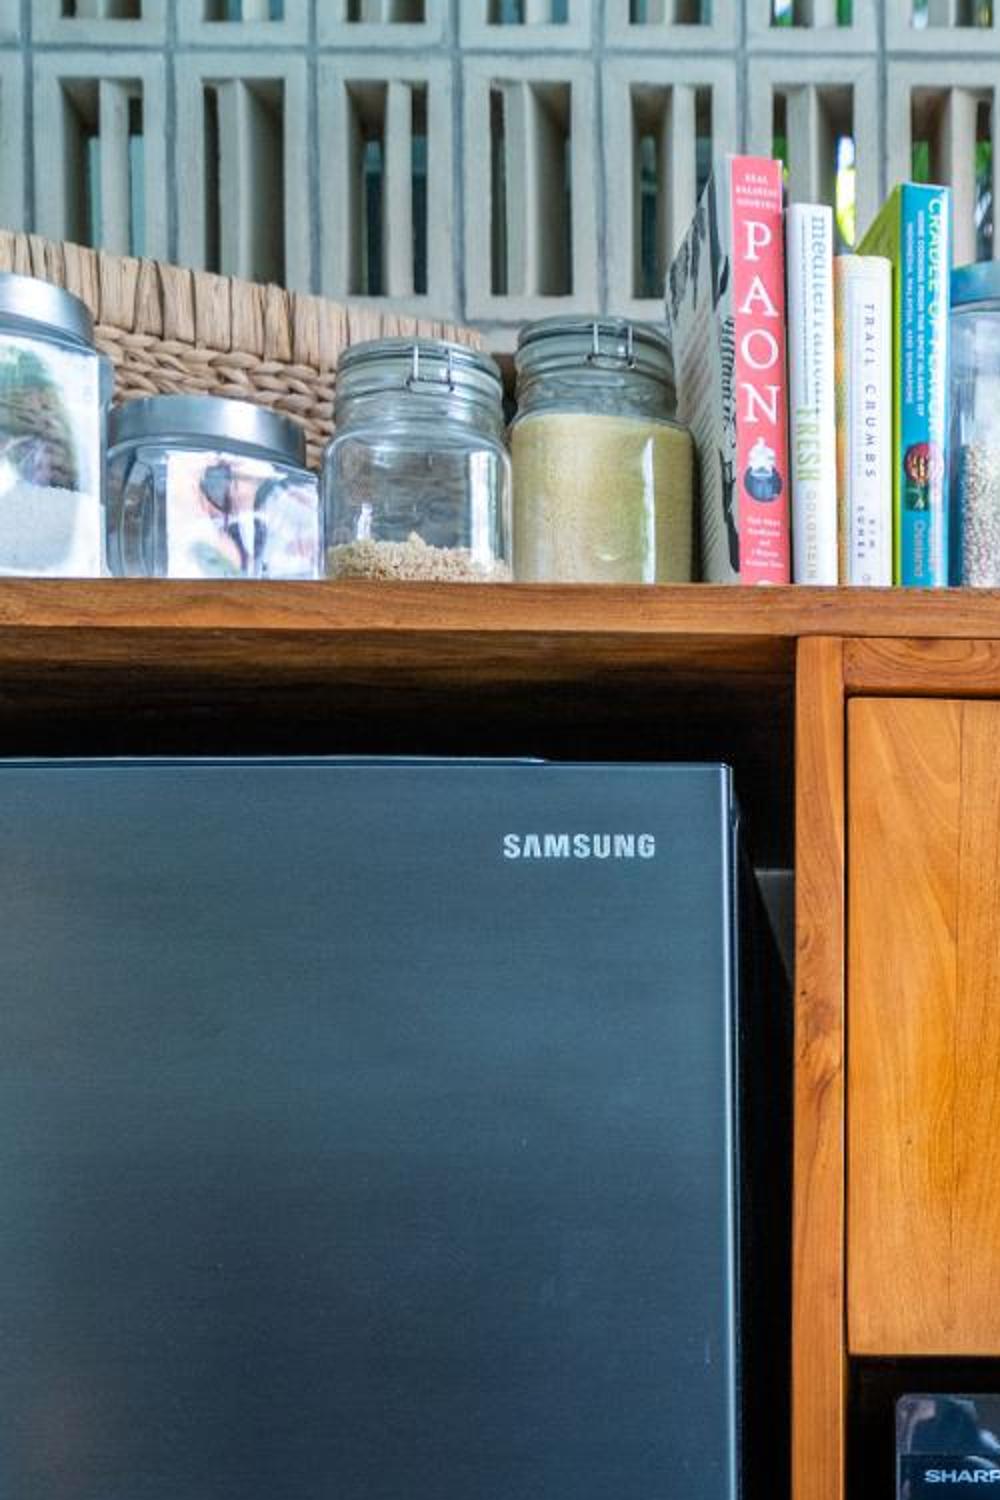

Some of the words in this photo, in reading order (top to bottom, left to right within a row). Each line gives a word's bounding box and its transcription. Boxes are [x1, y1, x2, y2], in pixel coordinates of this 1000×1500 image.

[738, 220, 782, 426] PAON
[863, 303, 876, 368] TRAIL
[864, 383, 878, 480] CRUMBS
[503, 833, 656, 859] SAMSUNG
